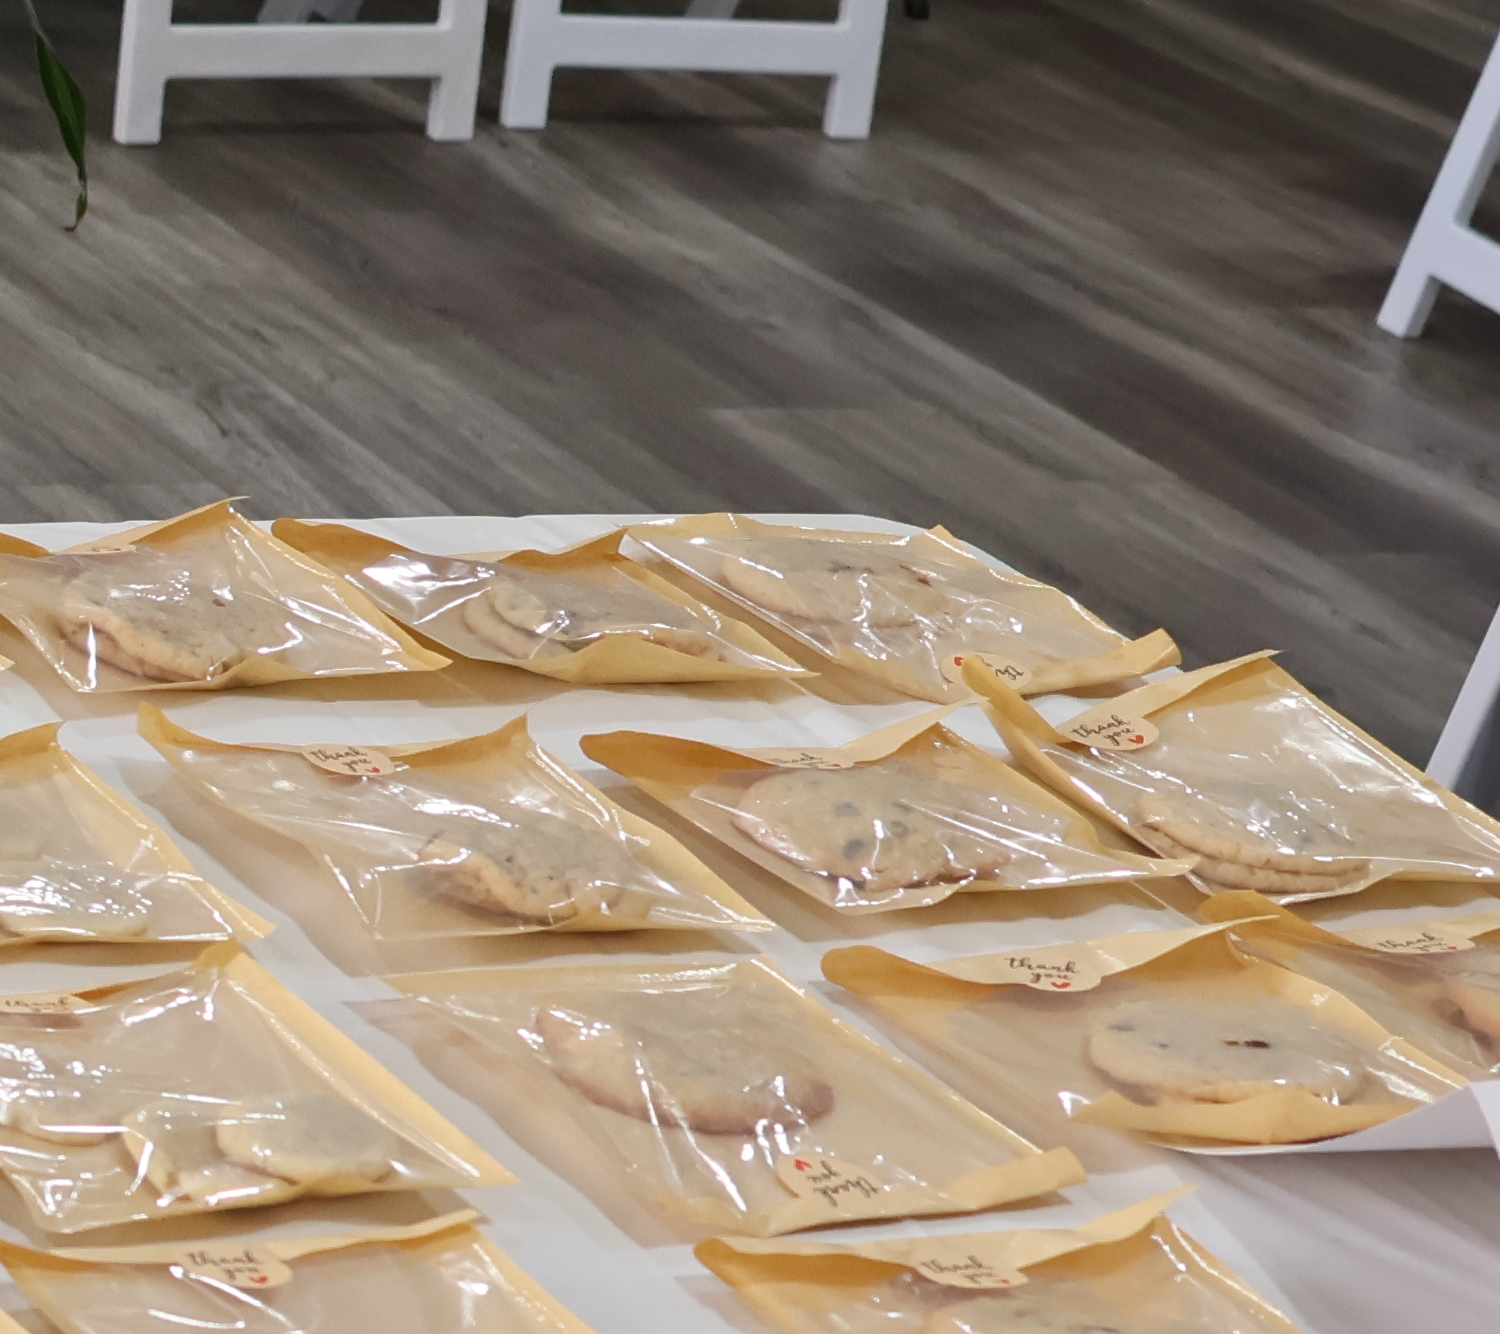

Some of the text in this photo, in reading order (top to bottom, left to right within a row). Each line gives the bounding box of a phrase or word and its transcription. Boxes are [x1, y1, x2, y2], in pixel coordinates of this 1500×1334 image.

[1070, 714, 1132, 740] thank
[1103, 727, 1136, 747] you
[308, 746, 368, 763] thank
[342, 758, 373, 773] you
[1004, 957, 1080, 974] thank
[1030, 971, 1075, 984] you
